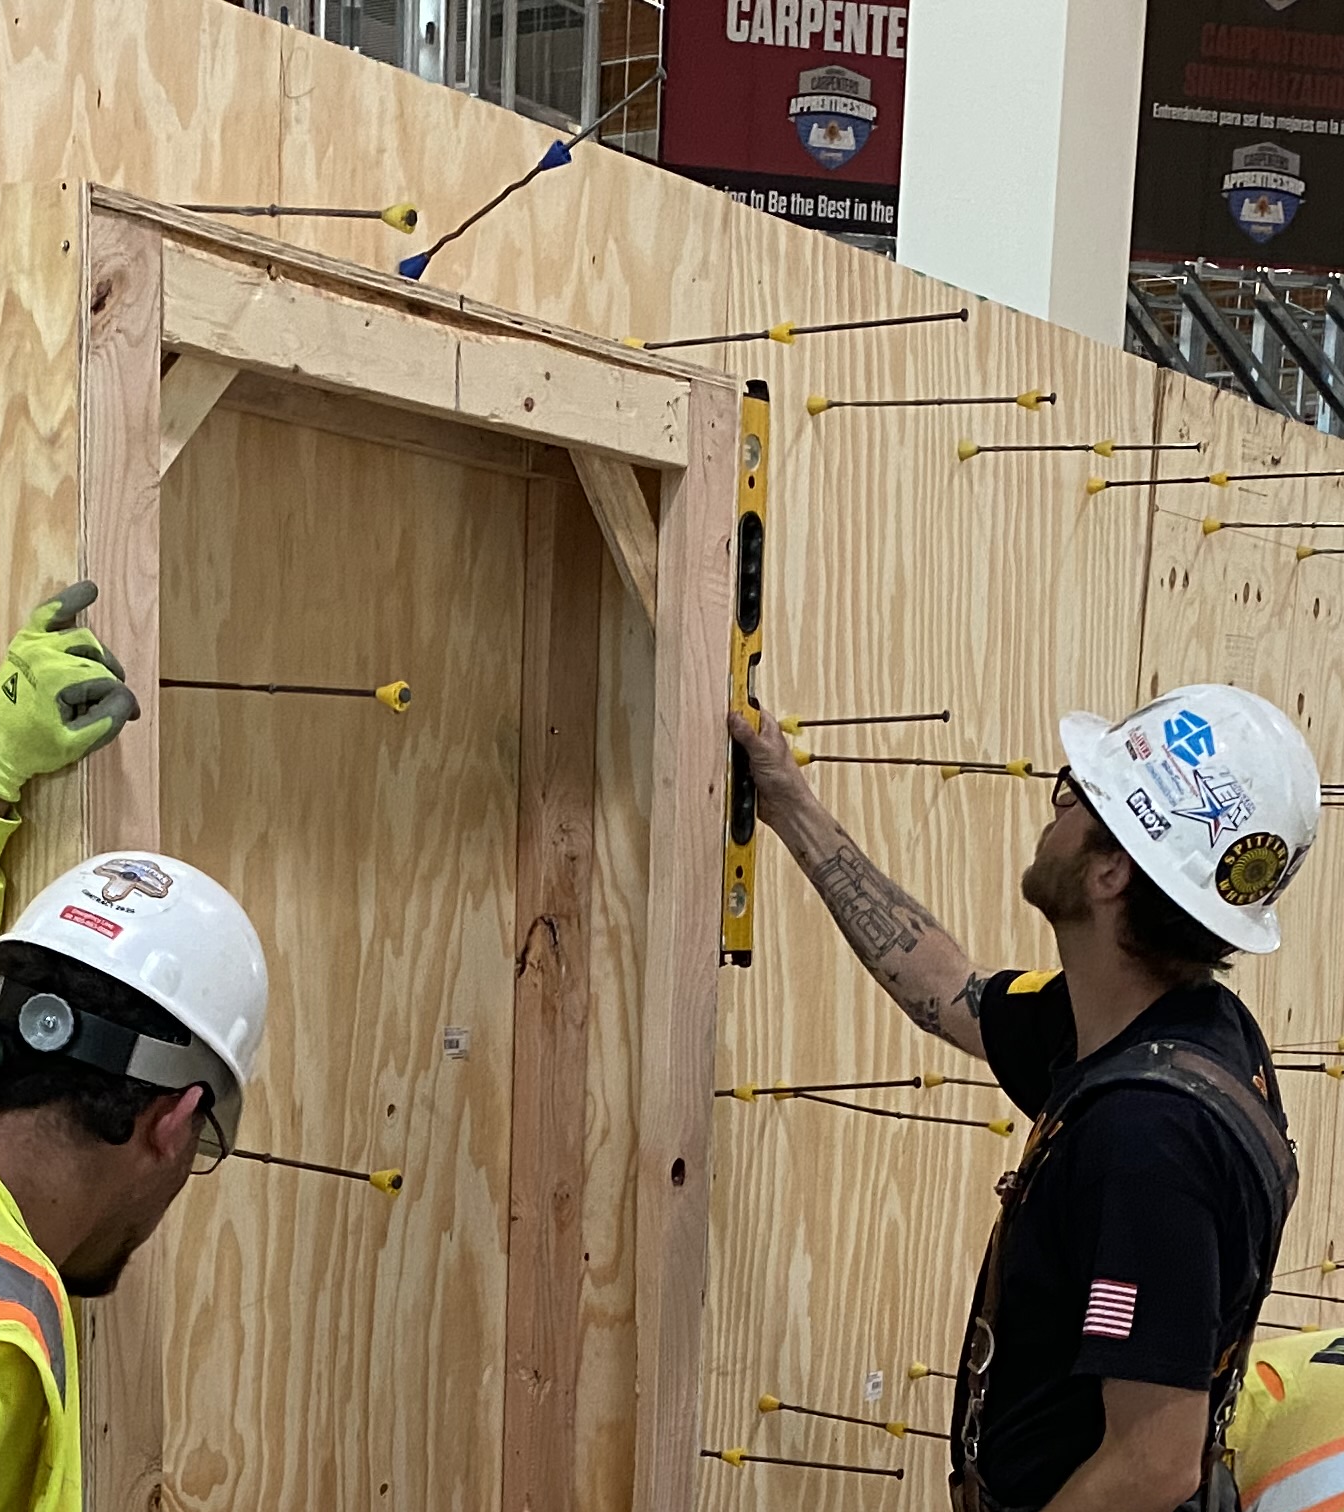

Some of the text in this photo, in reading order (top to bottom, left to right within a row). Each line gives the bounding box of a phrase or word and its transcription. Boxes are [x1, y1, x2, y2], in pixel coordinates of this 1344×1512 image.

[726, 0, 906, 58] CARPENTE
[768, 190, 787, 214] Be
[791, 193, 814, 217] the
[818, 195, 850, 220] Best
[854, 198, 867, 221] in
[870, 200, 894, 224] the
